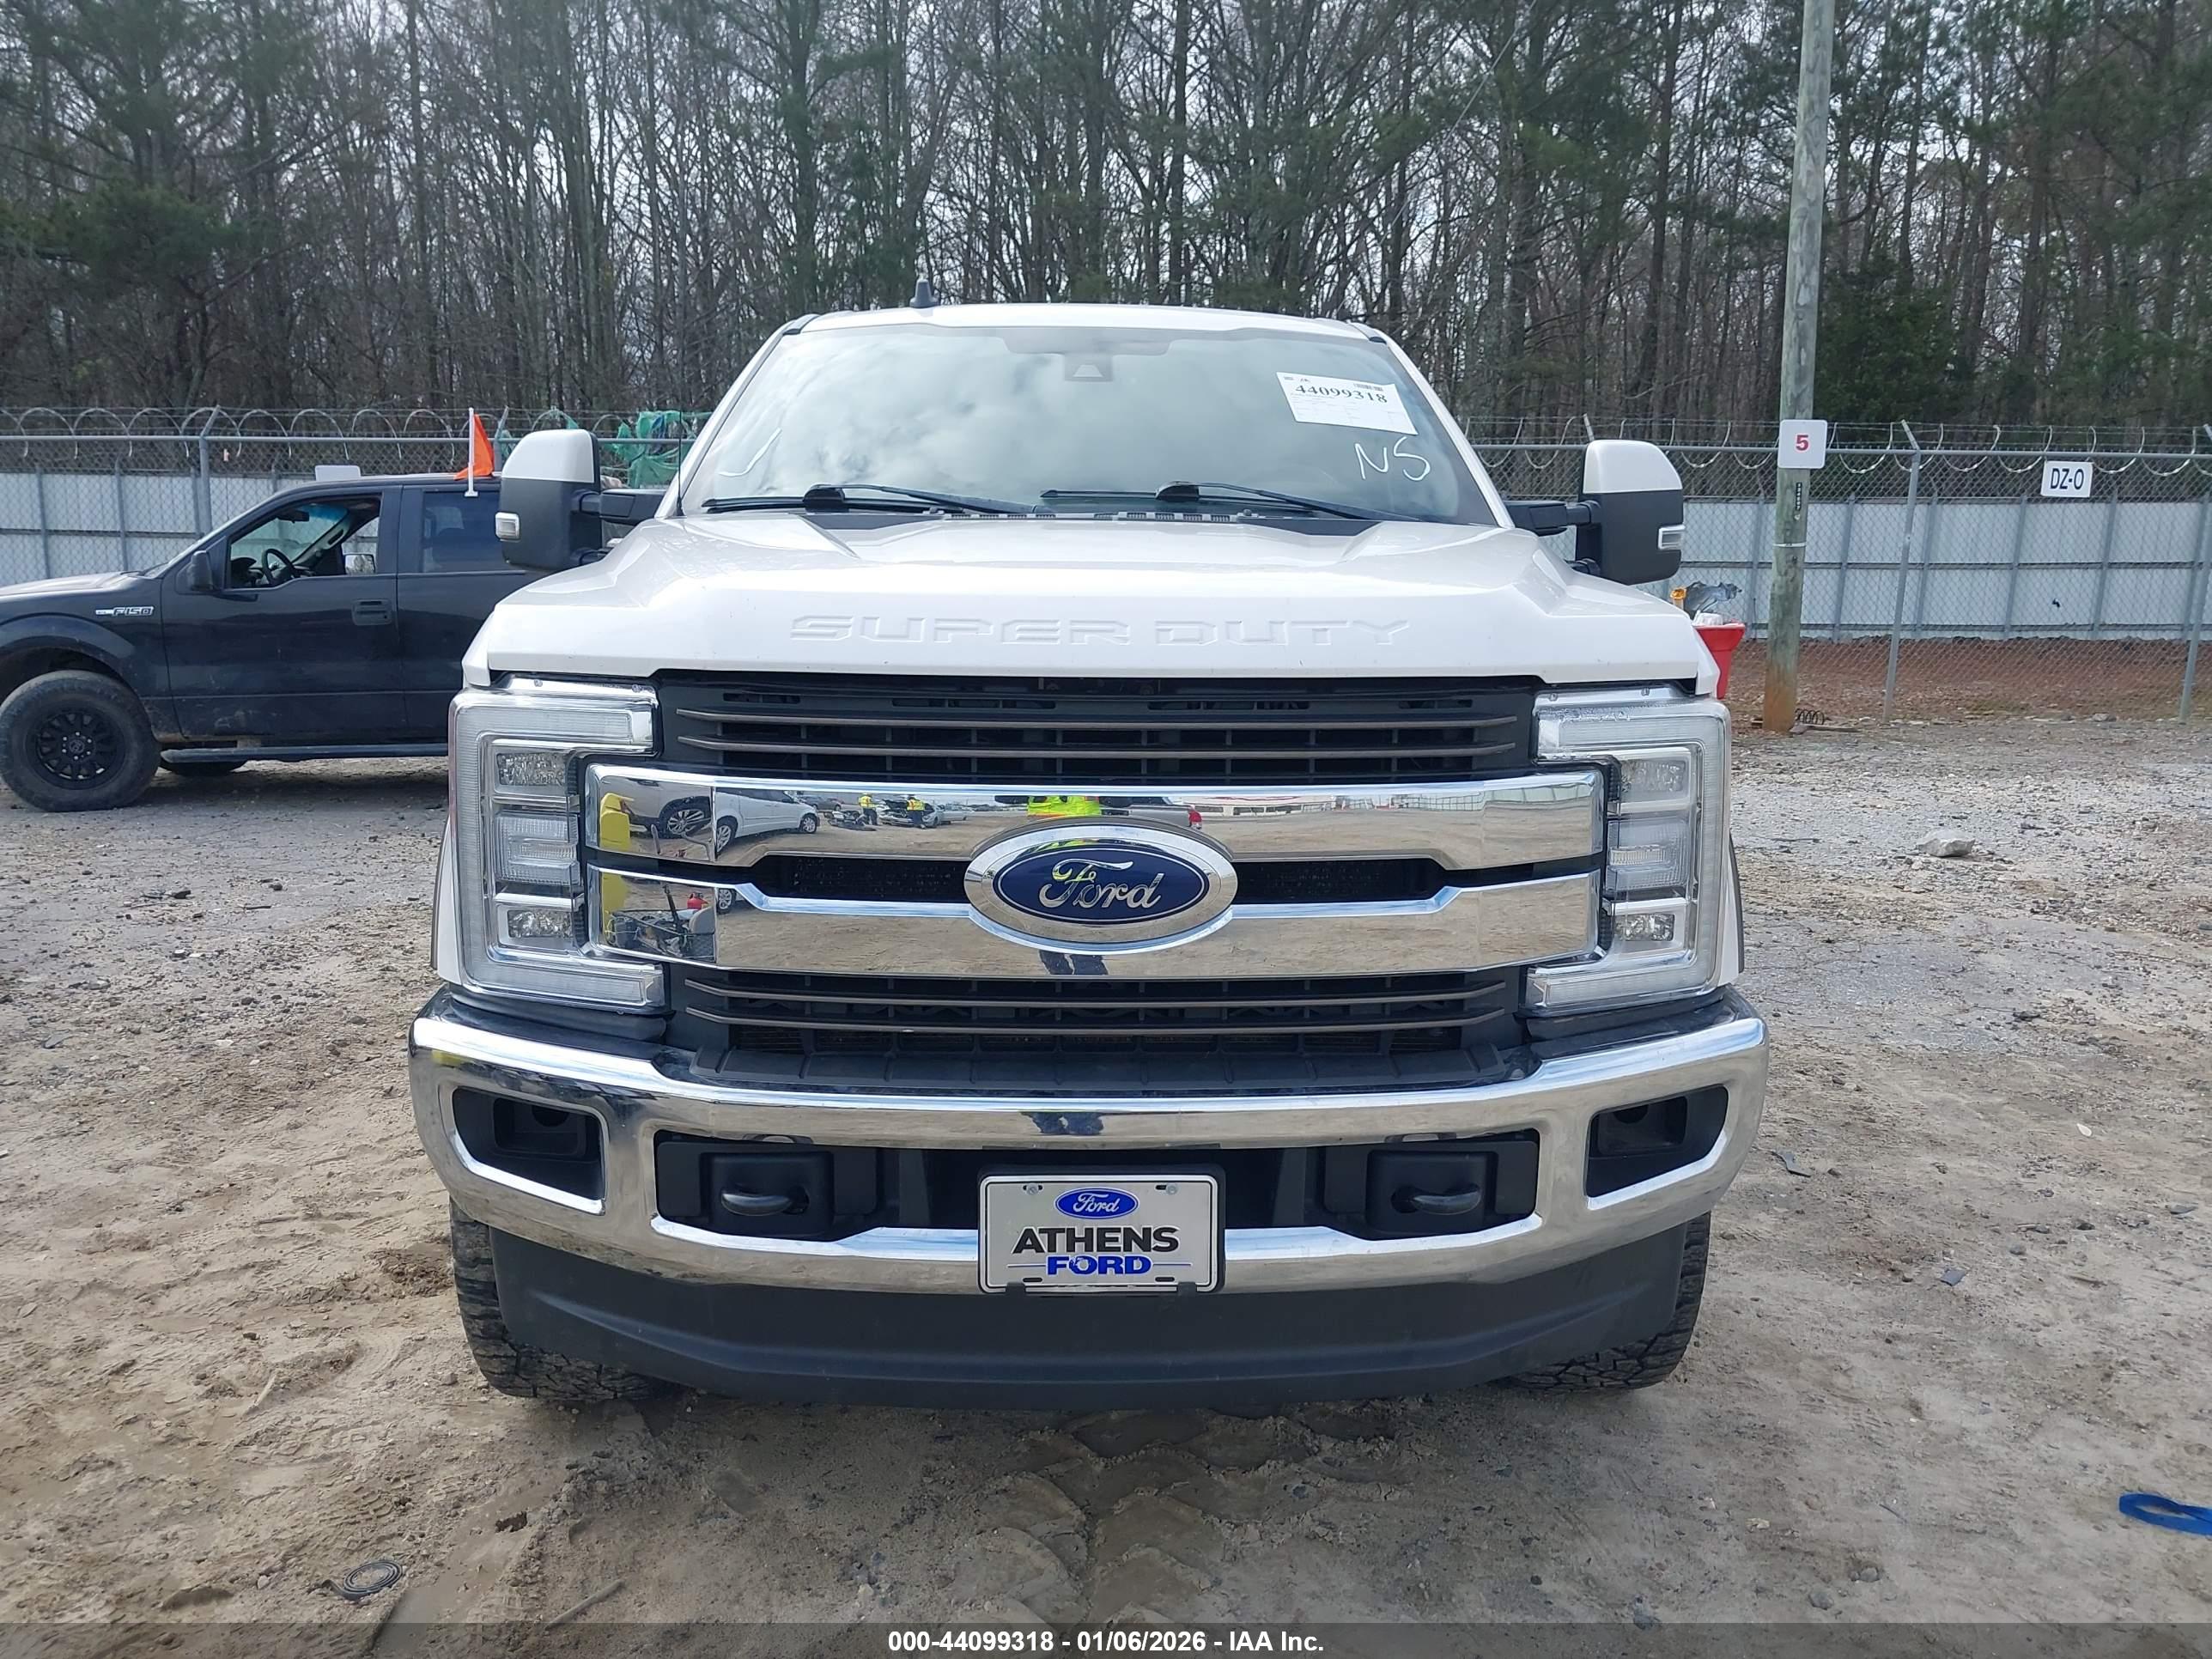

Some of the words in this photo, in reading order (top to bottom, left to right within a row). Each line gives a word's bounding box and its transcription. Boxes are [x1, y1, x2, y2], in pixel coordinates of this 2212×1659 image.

[1296, 385, 1388, 403] 44099318
[1796, 434, 1808, 451] 5
[1354, 435, 1431, 481] NS
[790, 615, 1130, 644] SUPER
[1155, 620, 1409, 645] DUTY
[1039, 858, 1164, 908] Ford
[1073, 1193, 1121, 1212] Ford
[1012, 1226, 1180, 1254] ATHENS
[1047, 1255, 1152, 1275] FORD
